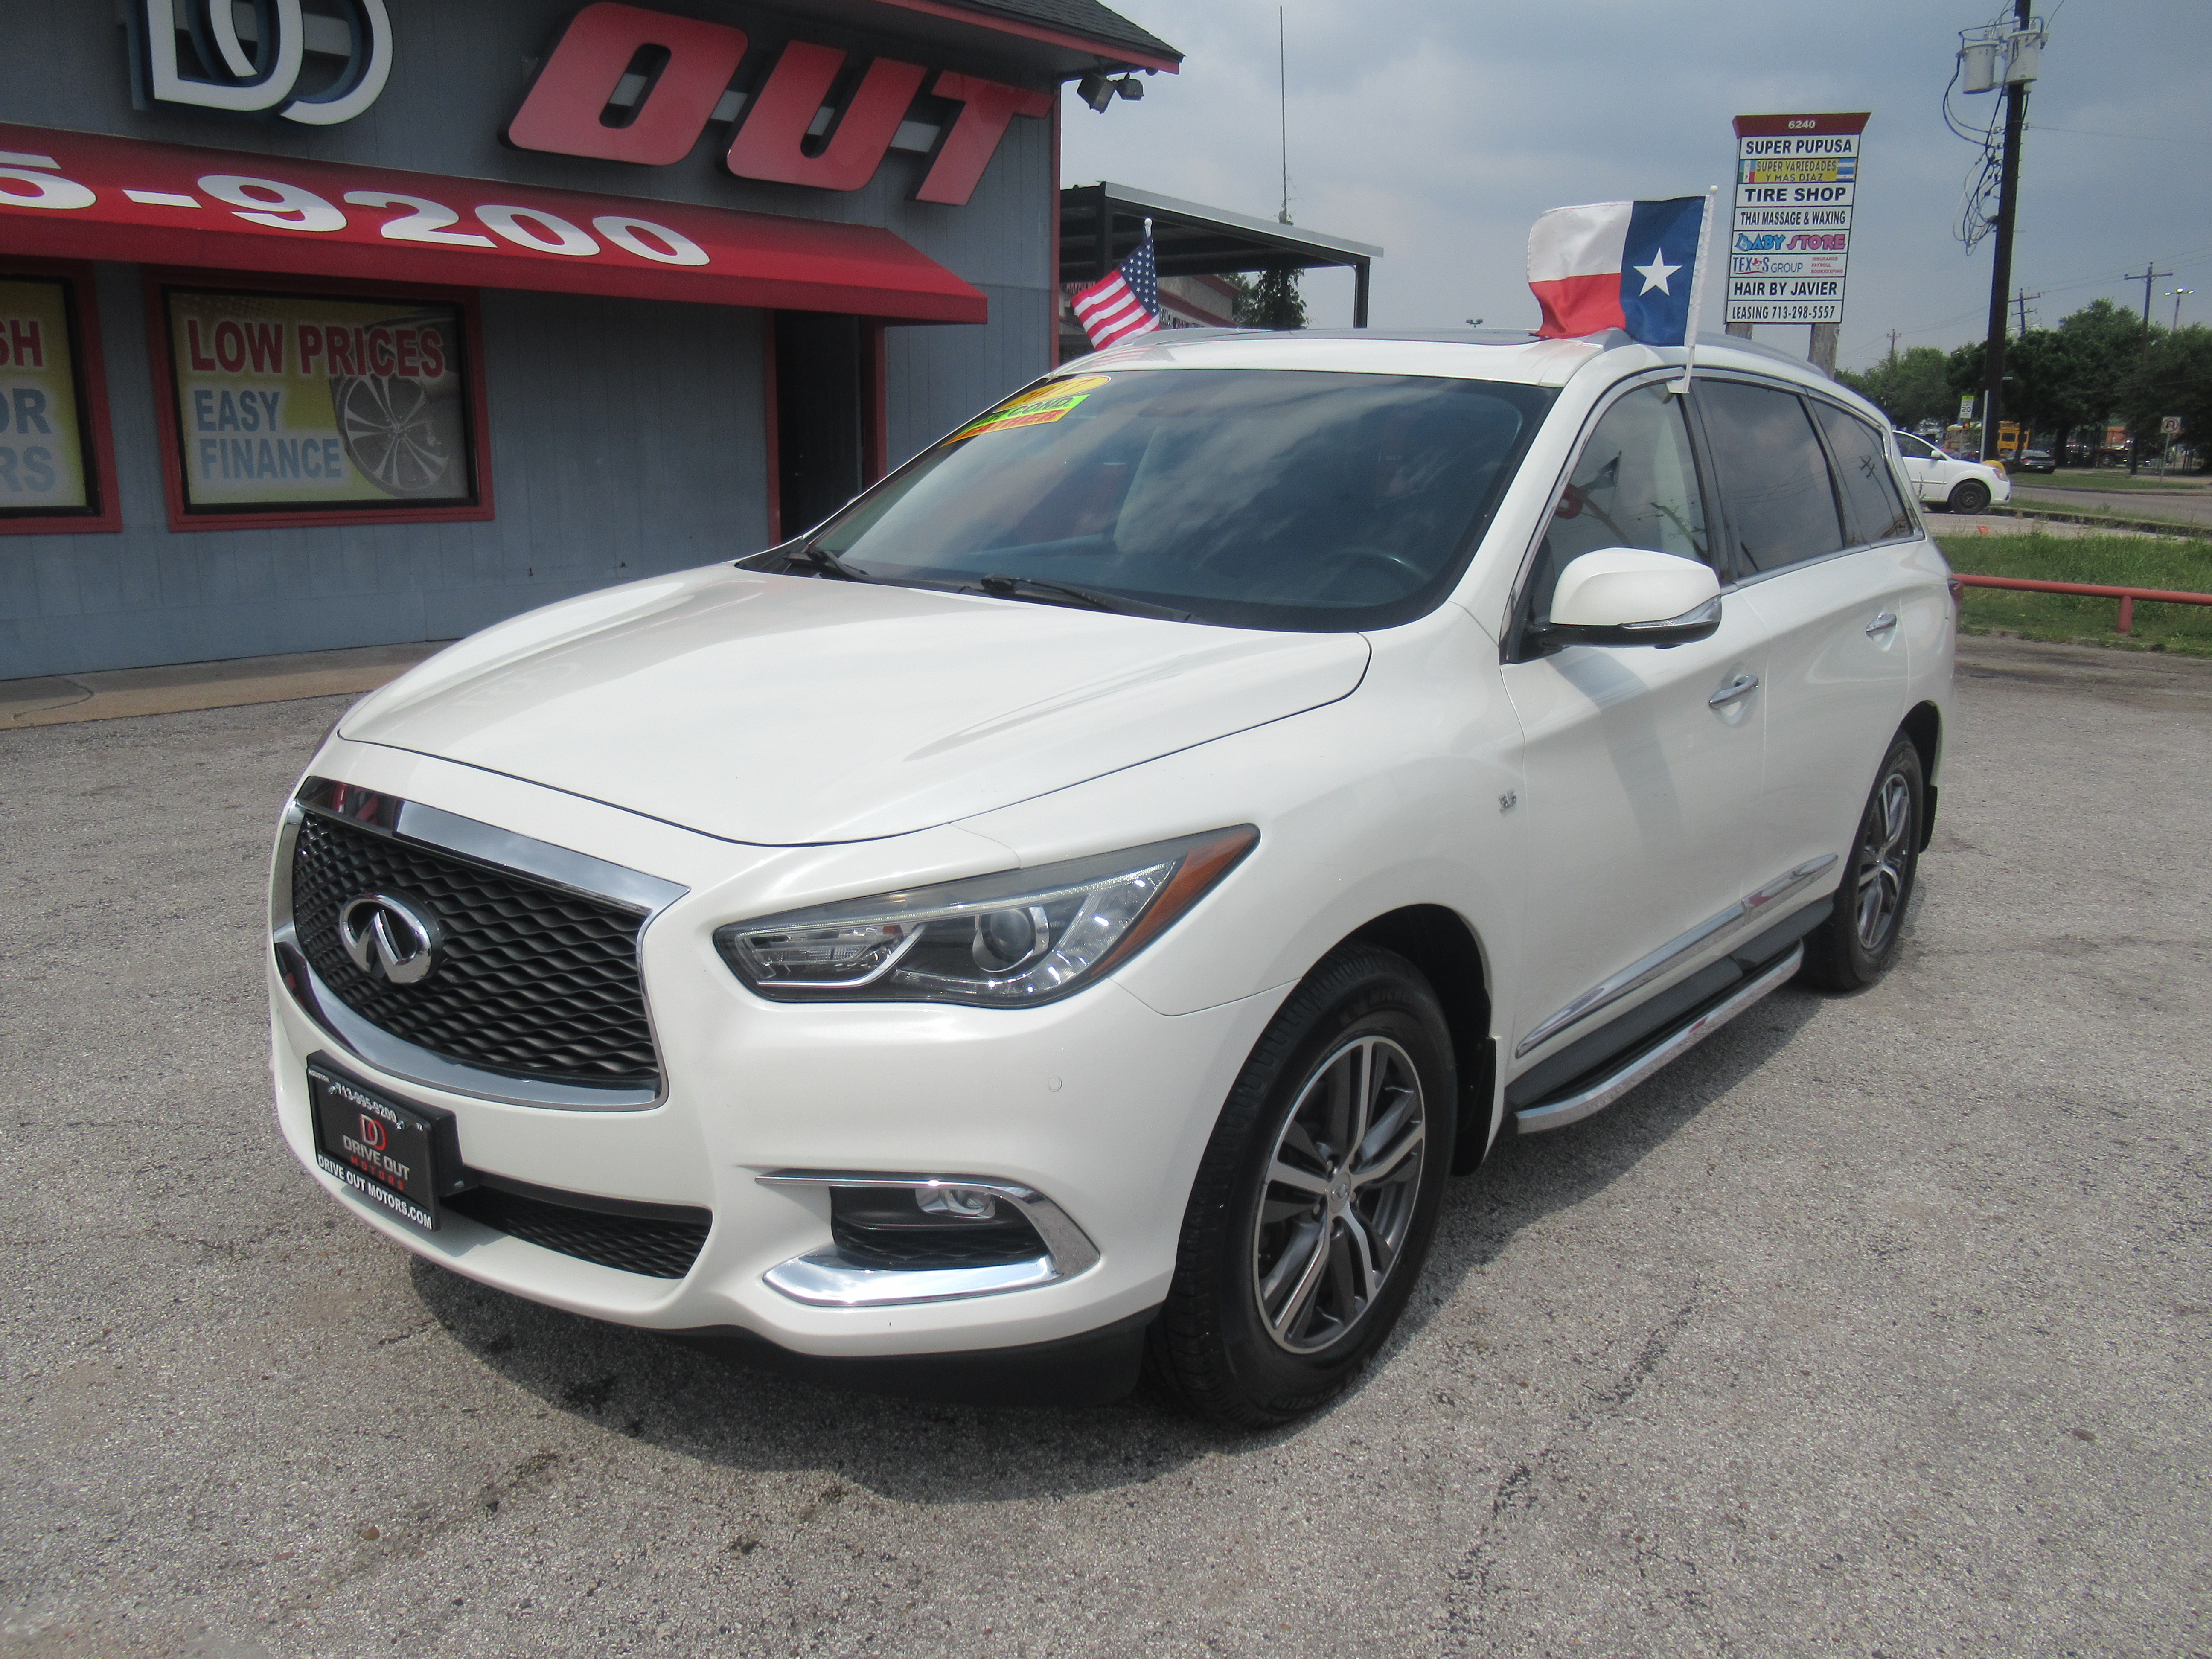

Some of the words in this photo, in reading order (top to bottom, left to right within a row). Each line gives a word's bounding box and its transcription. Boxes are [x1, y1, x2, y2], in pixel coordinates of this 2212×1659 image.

[508, 1, 1057, 207] OUT
[1788, 120, 1816, 129] 6240
[1746, 140, 1791, 154] SUPER
[1796, 138, 1852, 154] PUPUSA
[1756, 161, 1783, 172] SUPER
[1785, 160, 1836, 172] VARIEDADES
[1774, 173, 1796, 181] MAS
[1799, 173, 1823, 181] DIAZ
[1744, 188, 1788, 202] TIRE
[1793, 187, 1846, 202] SHOP
[1740, 212, 1760, 225] THAI
[1761, 211, 1802, 225] MASSAGE
[1803, 211, 1810, 225] &
[1812, 210, 1846, 224] WAXING
[1735, 233, 1786, 252] BABY
[1787, 234, 1846, 250] STORE
[1733, 256, 1770, 272] TEXS
[1771, 262, 1803, 273] GROUP
[1734, 282, 1765, 296] HAIR
[1769, 282, 1787, 296] BY
[1790, 282, 1837, 296] JAVIER
[1732, 306, 1769, 319] LEASING
[1772, 305, 1836, 319] 713-298-5557
[187, 320, 283, 373] LOW
[298, 325, 445, 379] PRICES
[194, 390, 282, 432] EASY
[200, 437, 342, 481] FINANCE
[342, 1134, 382, 1166] DRIVE
[384, 1155, 411, 1180] OUT
[351, 1155, 405, 1190] MOTORS
[317, 1153, 346, 1180] DRIVE
[346, 1170, 366, 1192] OUT
[367, 1182, 433, 1230] MOTORS.COM
